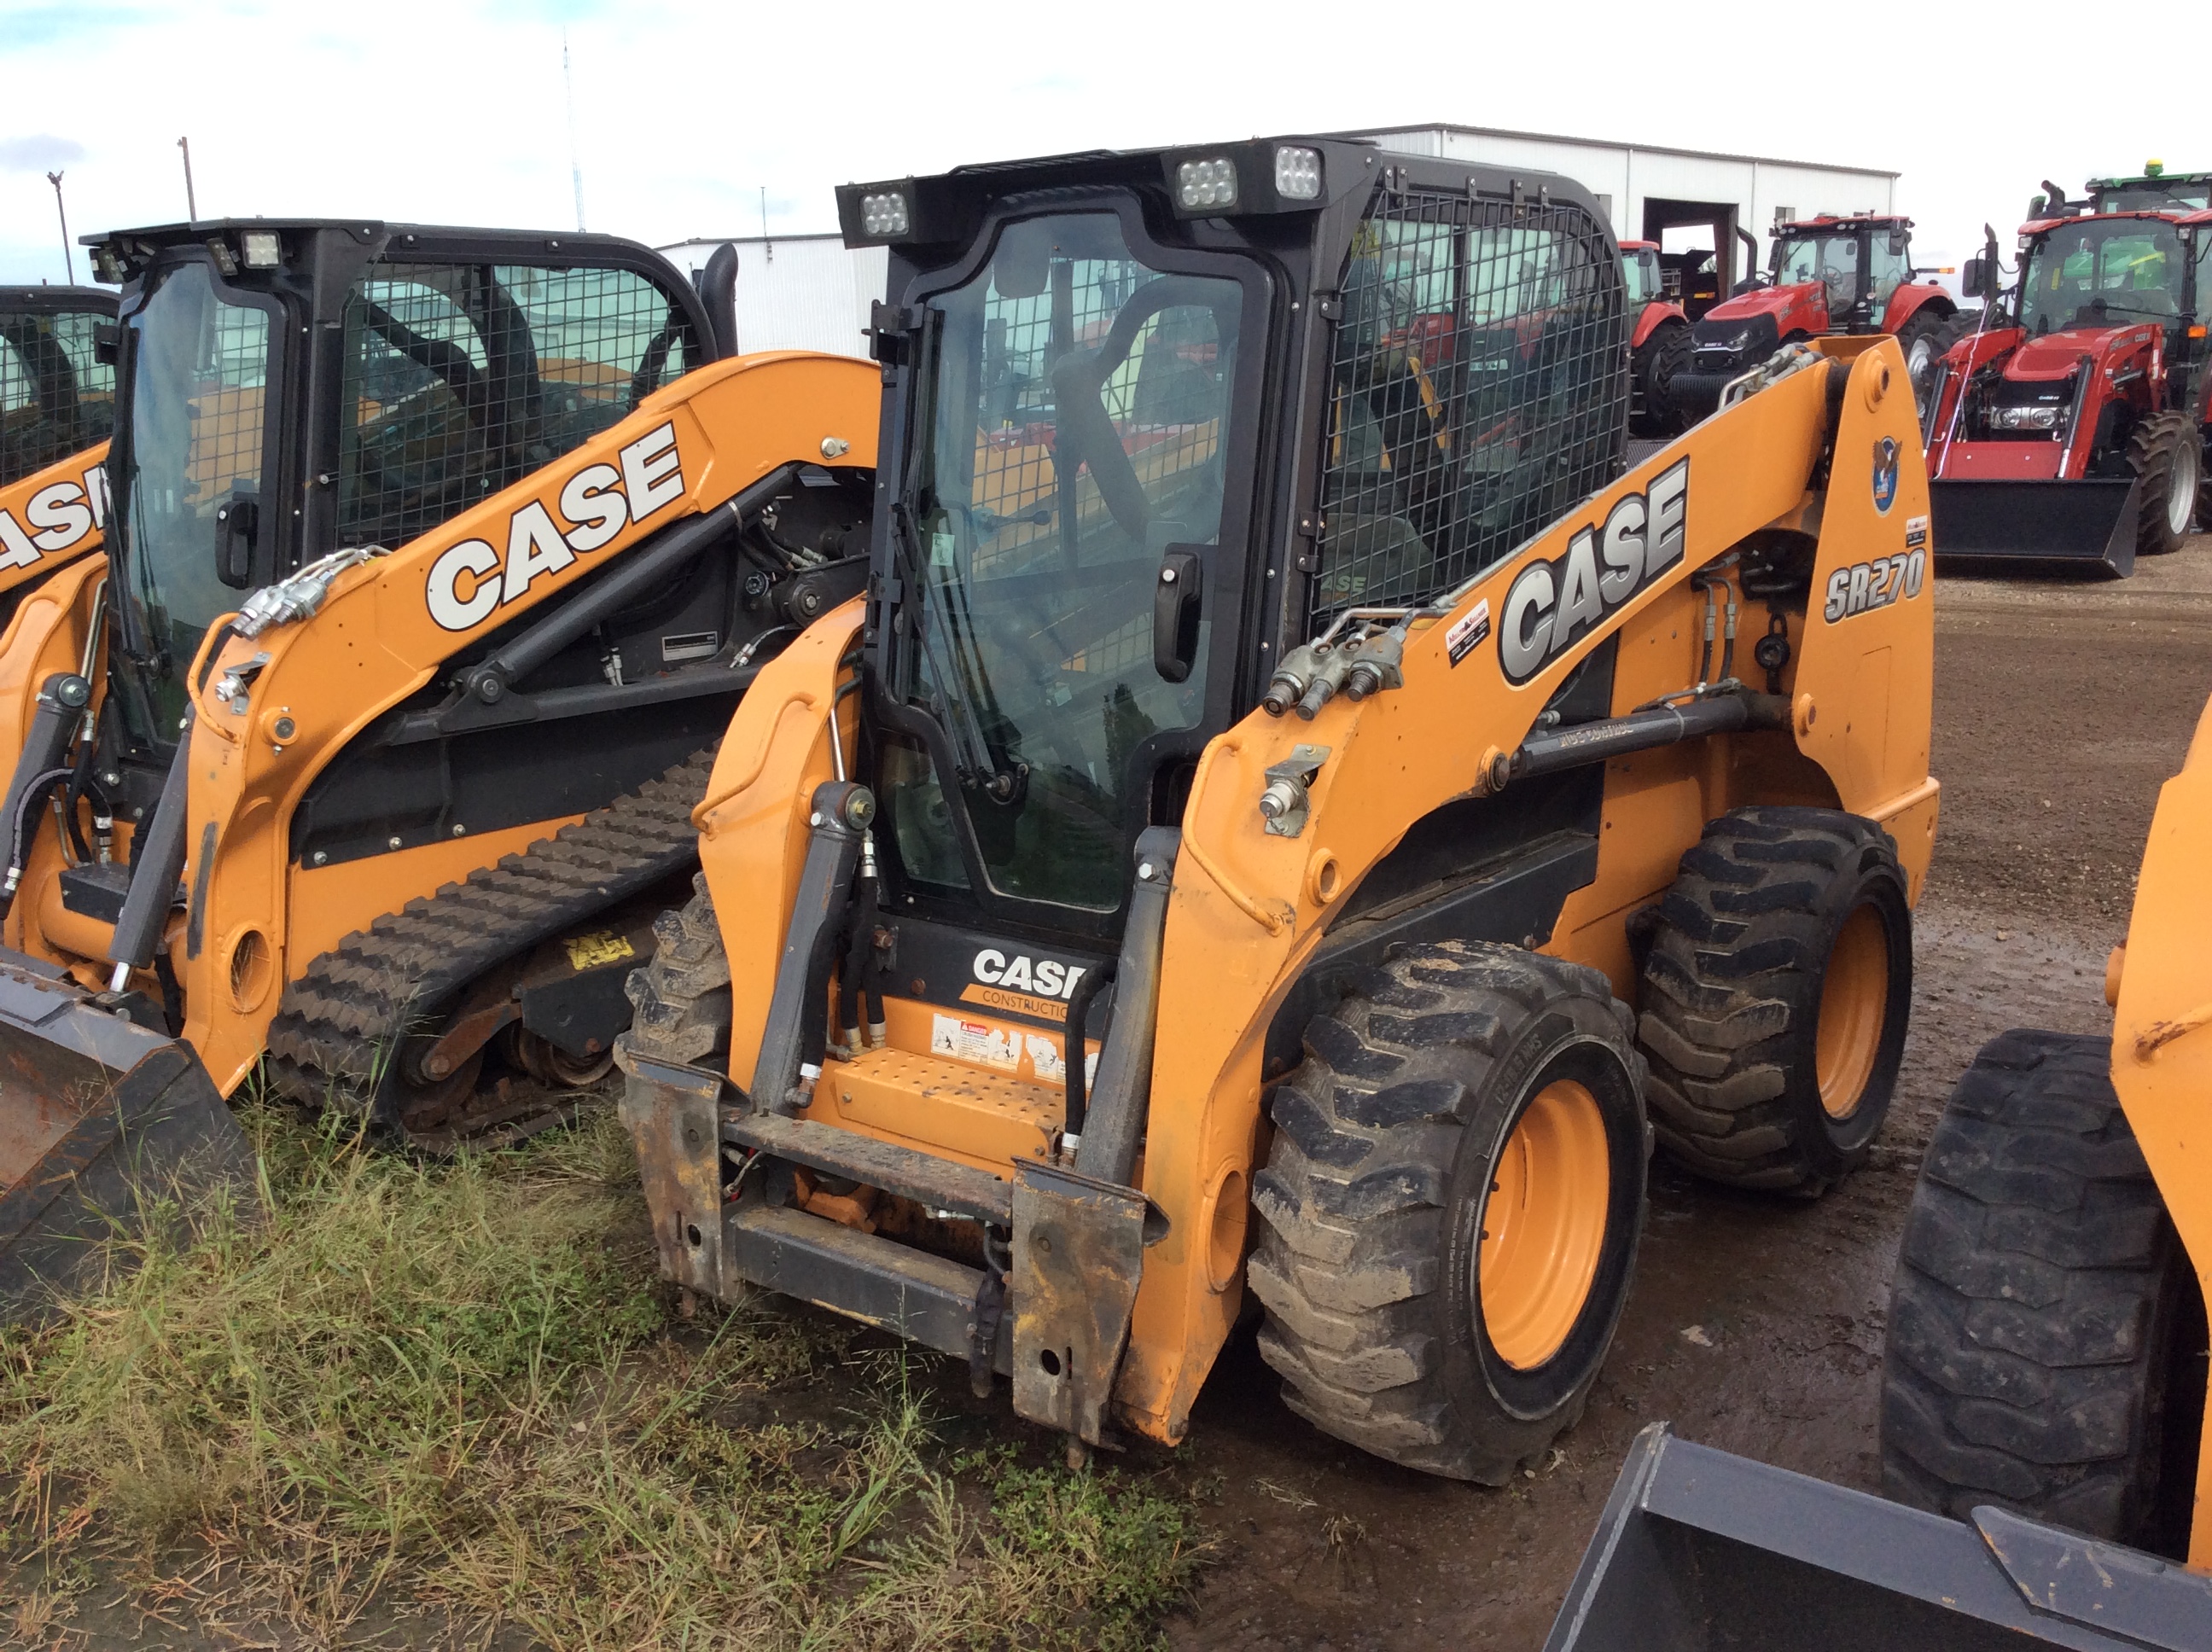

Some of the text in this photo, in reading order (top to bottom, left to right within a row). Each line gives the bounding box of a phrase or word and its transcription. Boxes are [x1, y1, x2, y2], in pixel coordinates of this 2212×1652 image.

[0, 465, 112, 571] AS
[425, 419, 686, 631] CASE
[1499, 456, 1689, 683] CASE
[1321, 575, 1366, 591] ASE
[1825, 547, 1926, 624] SR270
